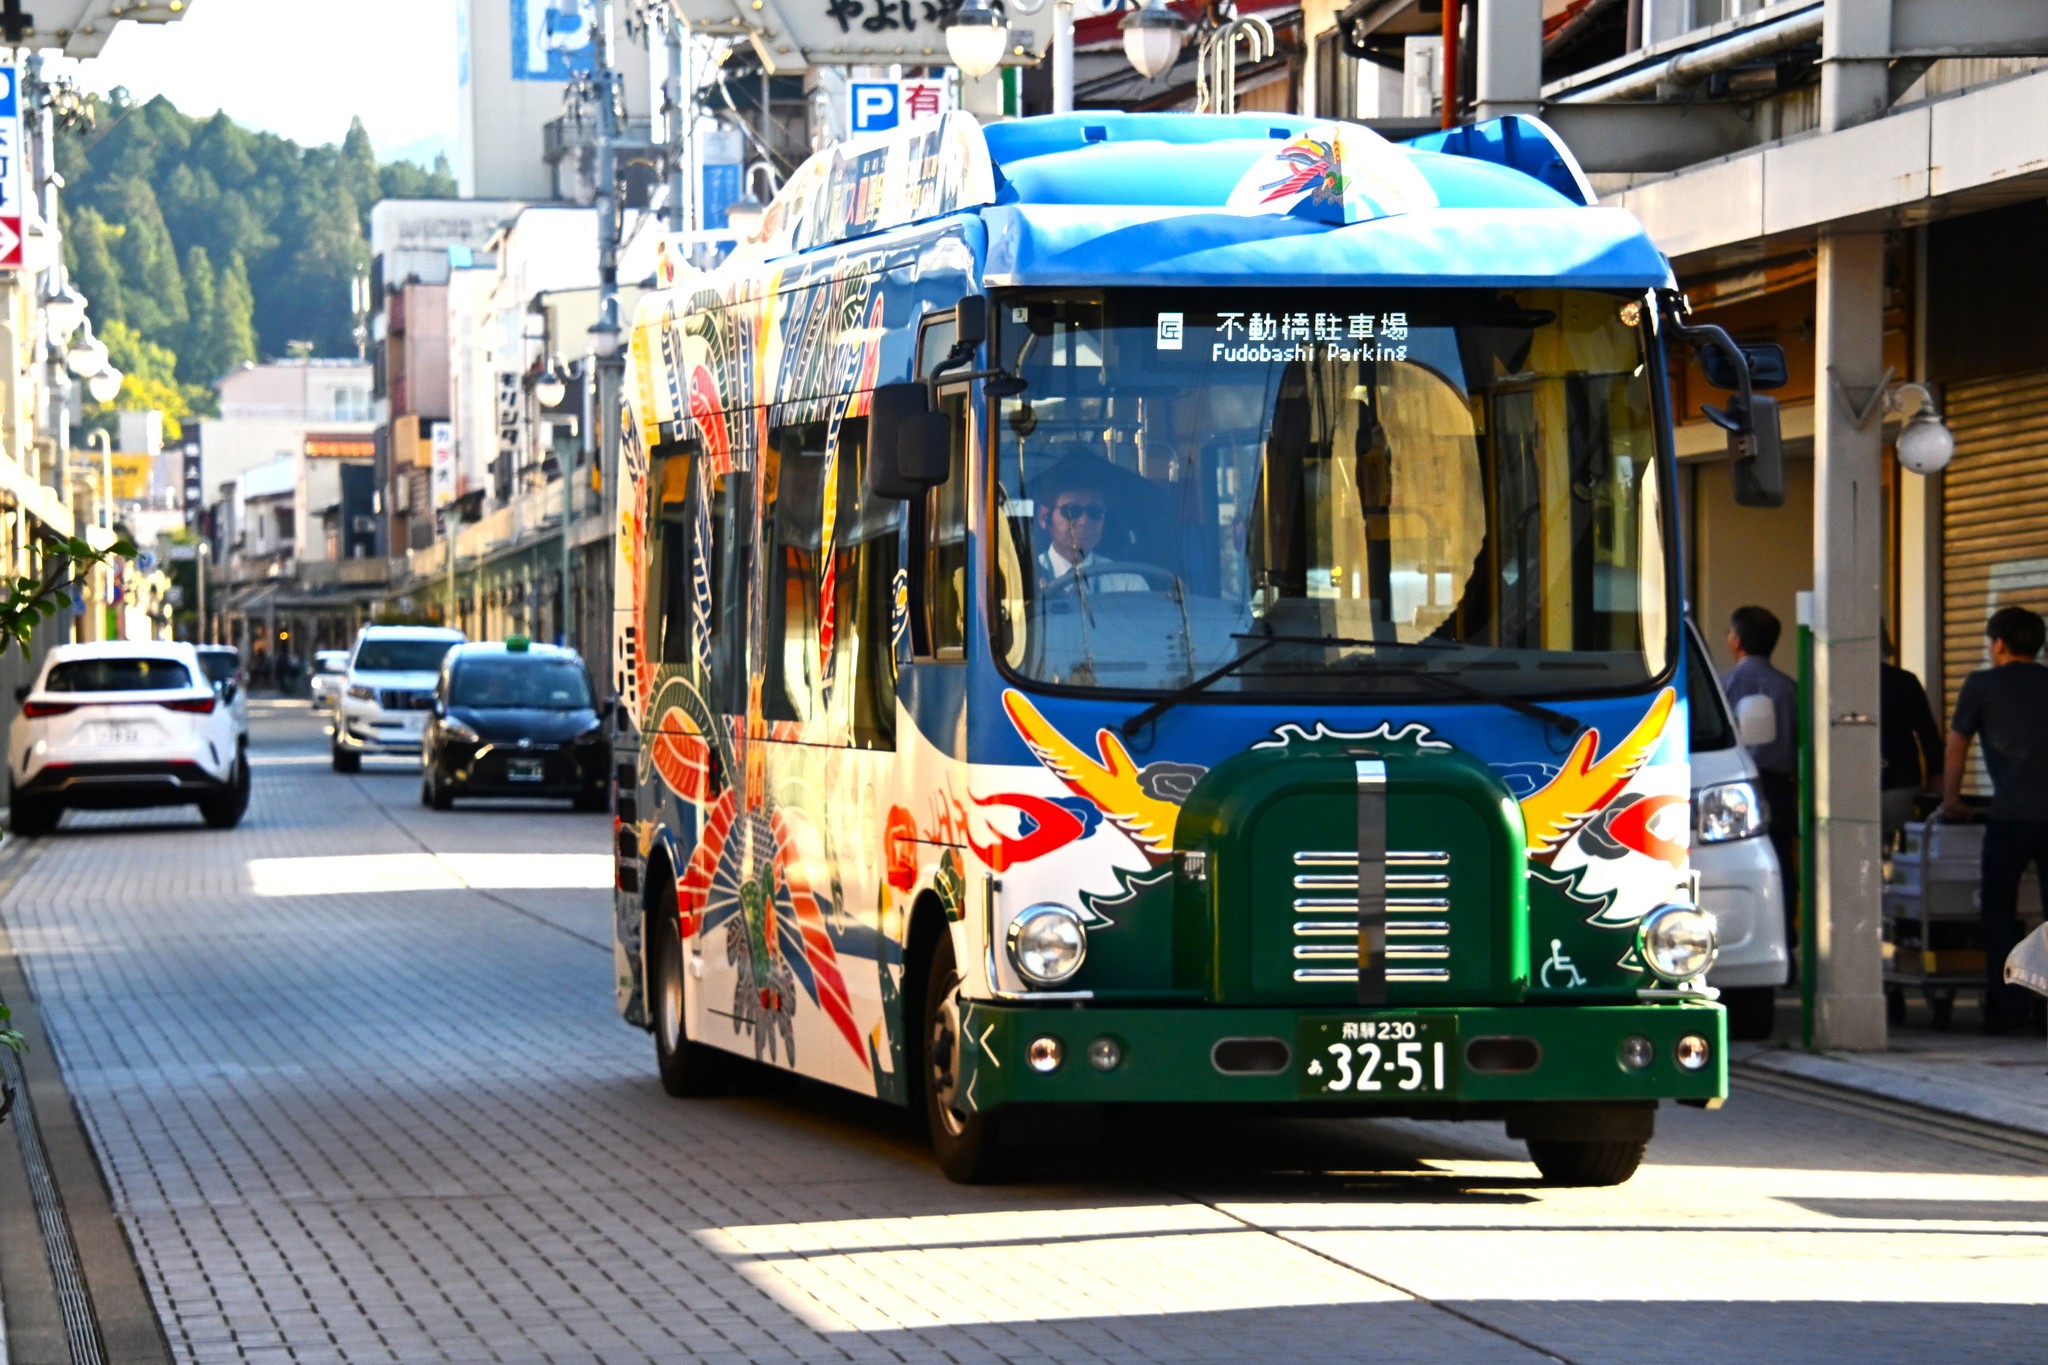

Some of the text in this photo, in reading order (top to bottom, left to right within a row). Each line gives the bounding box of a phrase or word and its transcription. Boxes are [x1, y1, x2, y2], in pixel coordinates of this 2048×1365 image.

[857, 83, 941, 128] P 有
[1216, 312, 1409, 341] 不動橋駐車場
[1212, 343, 1408, 362] Fudobashi Parking
[1327, 1041, 1445, 1091] 32-51
